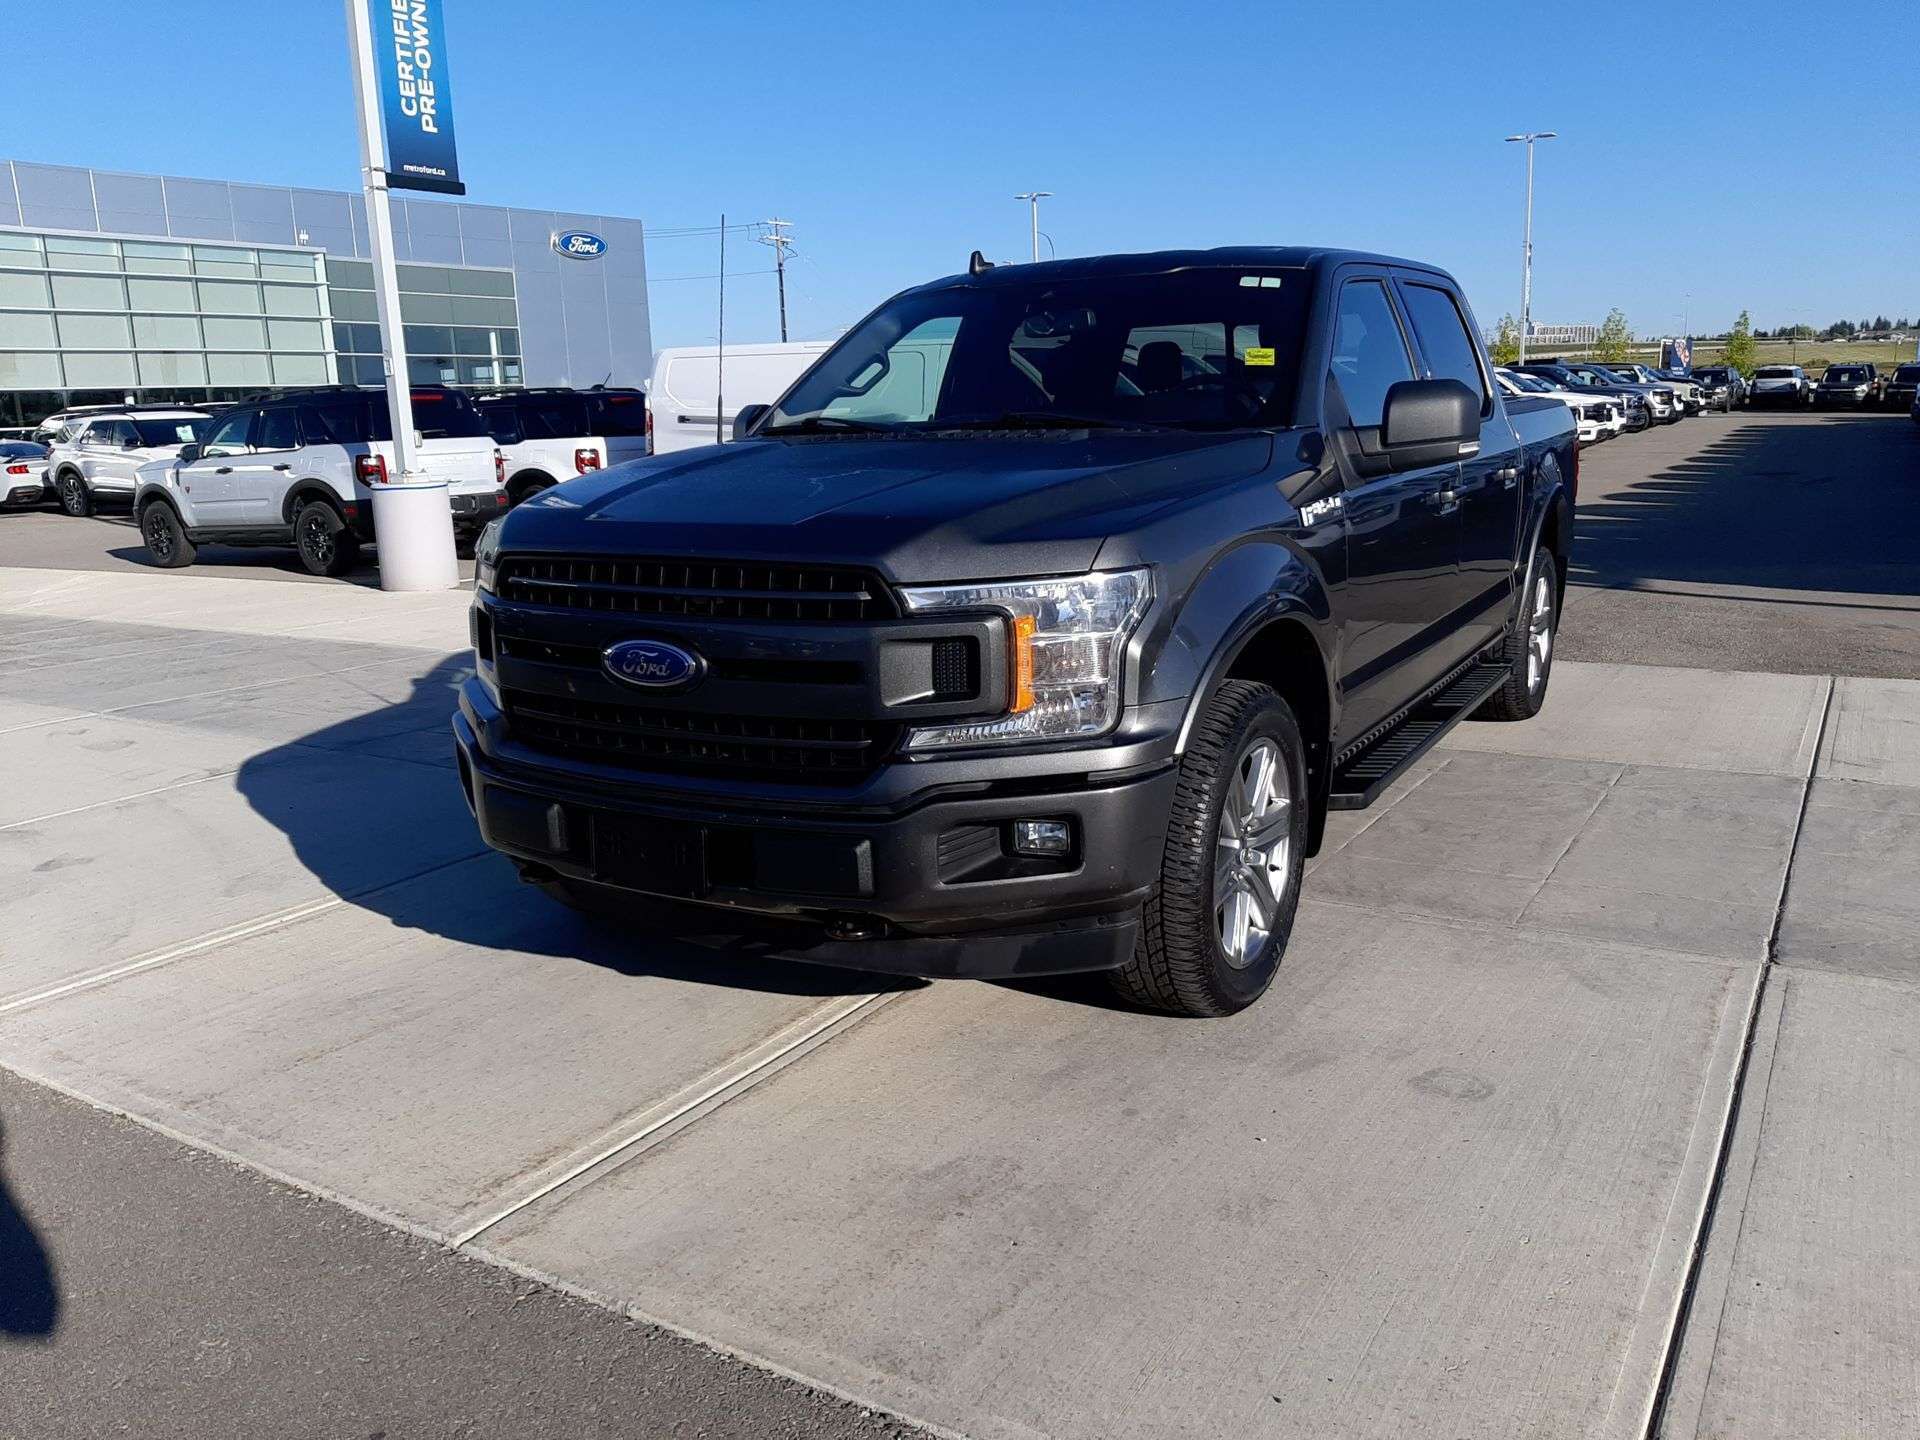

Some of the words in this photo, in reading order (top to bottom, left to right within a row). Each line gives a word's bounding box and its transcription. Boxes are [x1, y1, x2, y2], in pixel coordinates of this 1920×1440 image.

[410, 0, 439, 133] PRE-OWN
[403, 164, 446, 177] metroford.ca
[568, 236, 599, 253] Ford
[622, 649, 672, 676] Ford
